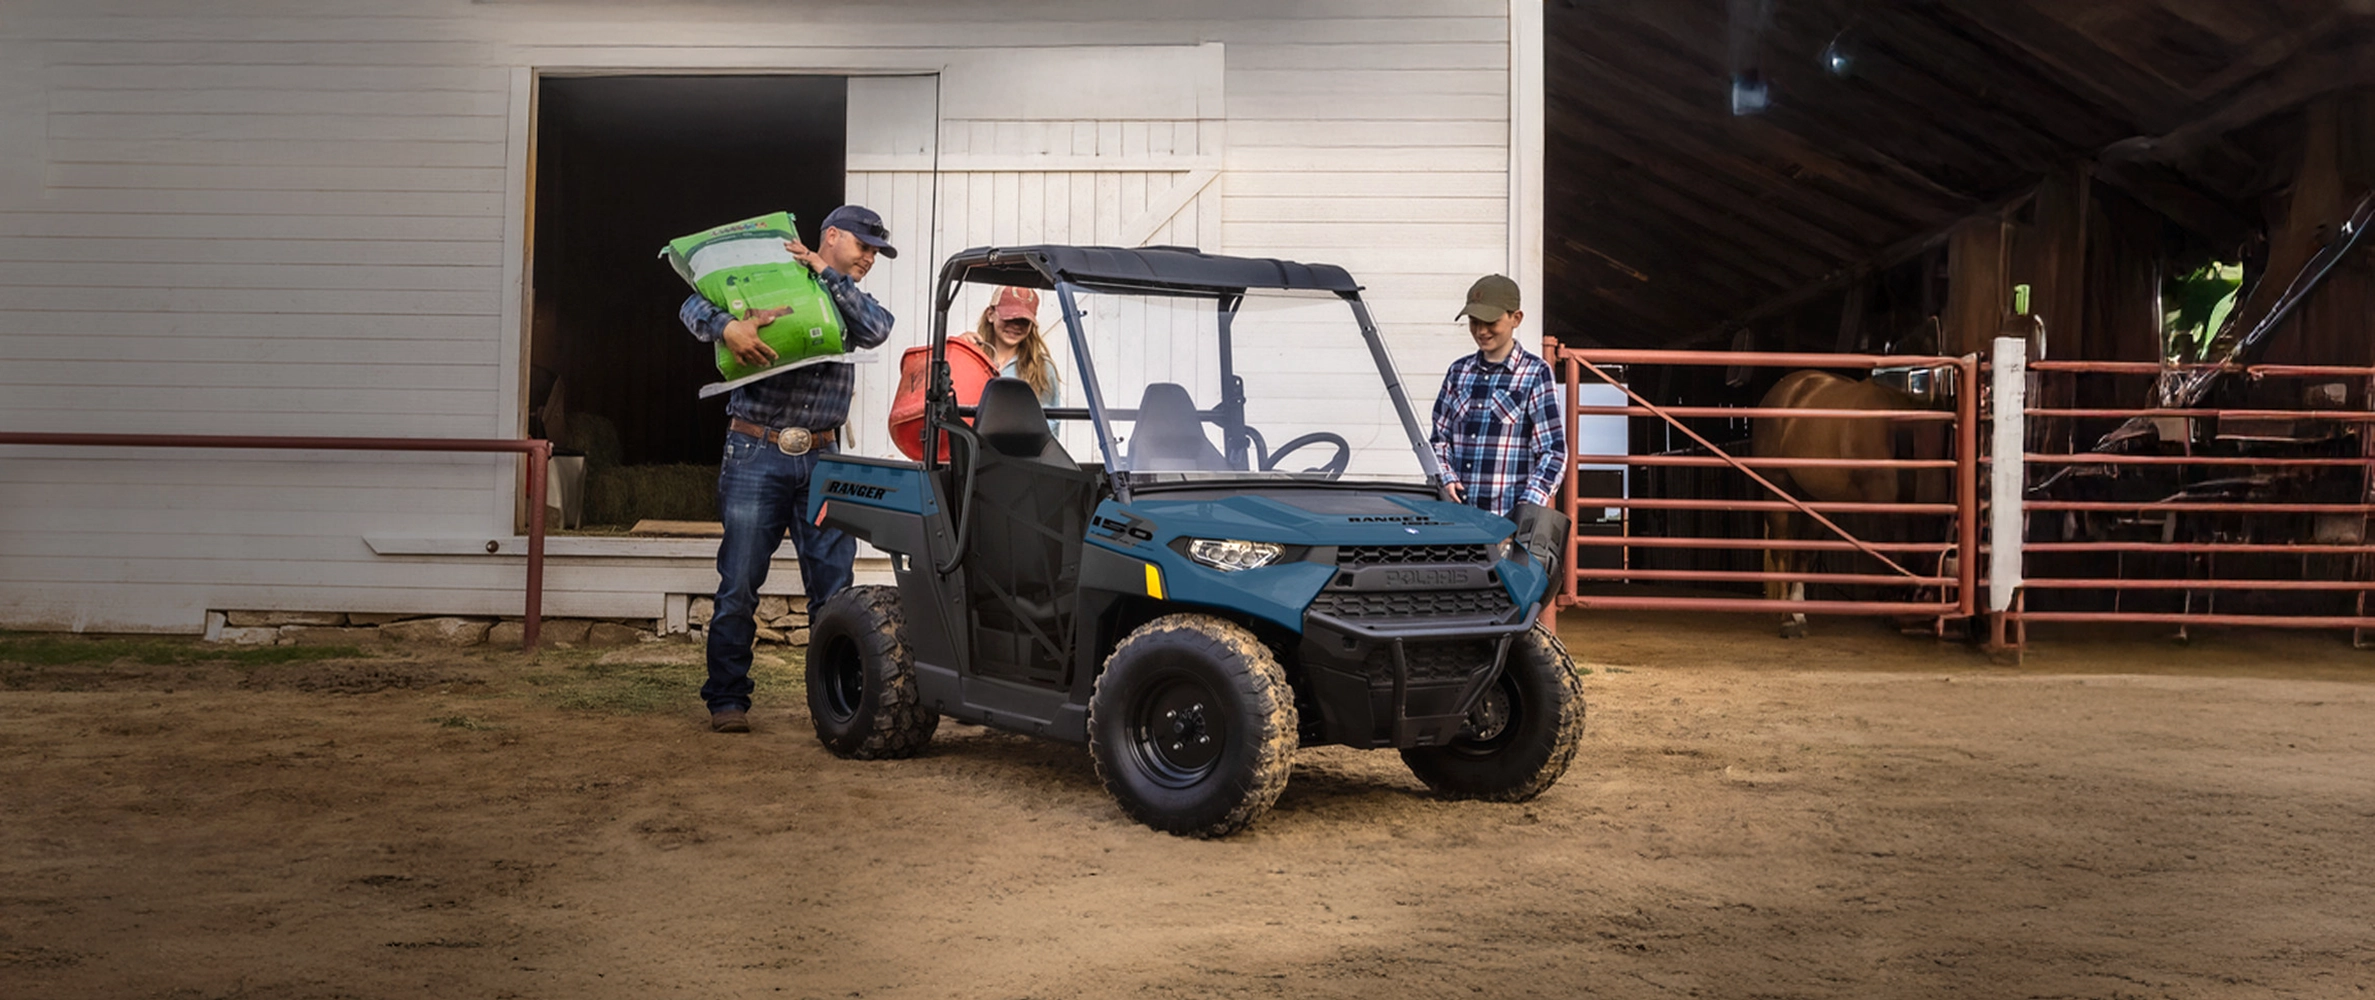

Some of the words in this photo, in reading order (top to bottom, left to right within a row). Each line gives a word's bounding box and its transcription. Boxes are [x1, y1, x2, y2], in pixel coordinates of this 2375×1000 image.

[828, 481, 886, 500] RANGER
[1092, 515, 1153, 541] 150
[1386, 570, 1468, 584] POLARIS
